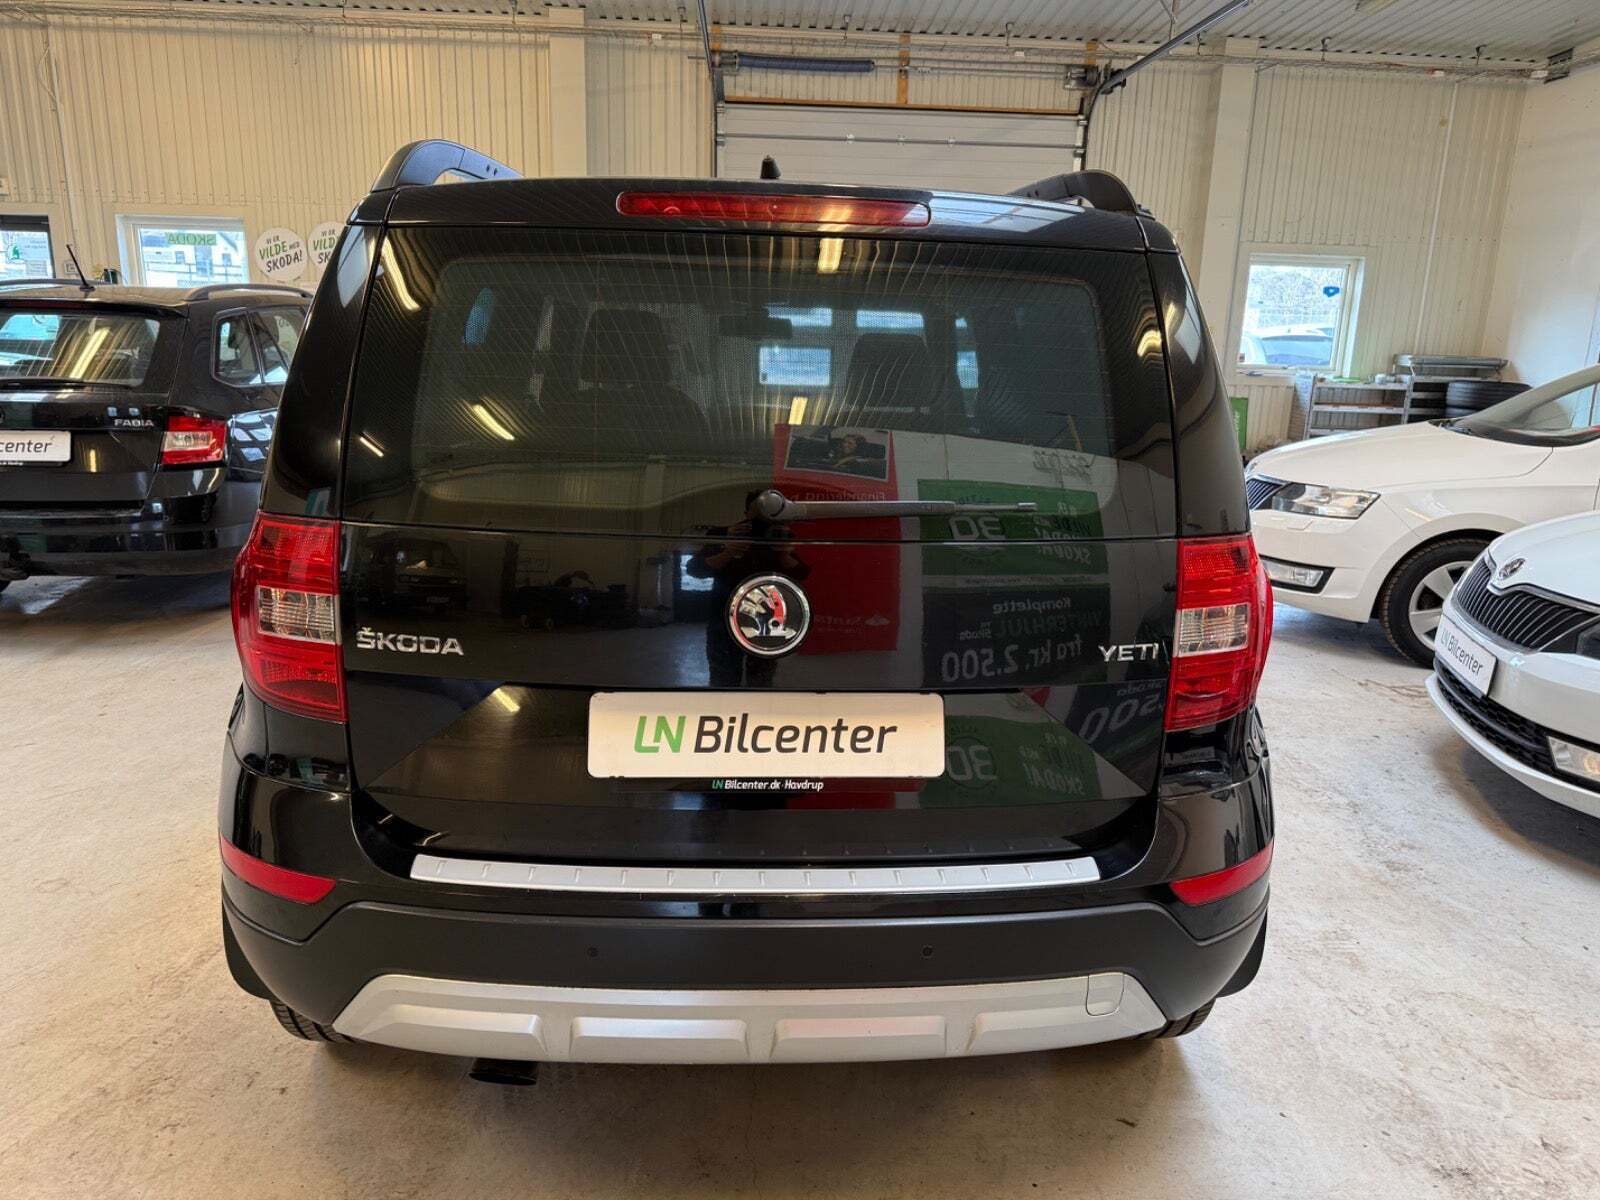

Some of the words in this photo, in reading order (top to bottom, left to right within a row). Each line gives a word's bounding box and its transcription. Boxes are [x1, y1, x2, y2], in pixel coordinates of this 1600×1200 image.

[259, 241, 288, 260] VILDE
[313, 236, 340, 251] VILD
[266, 249, 303, 273] SKODA!
[114, 419, 154, 427] FABIA
[356, 626, 464, 656] ŠKODA
[1098, 642, 1159, 662] YETI
[1447, 635, 1484, 676] Bilcenter
[634, 716, 686, 753] LN
[694, 713, 897, 753] Bilcenter
[784, 780, 824, 792] Havdrup
